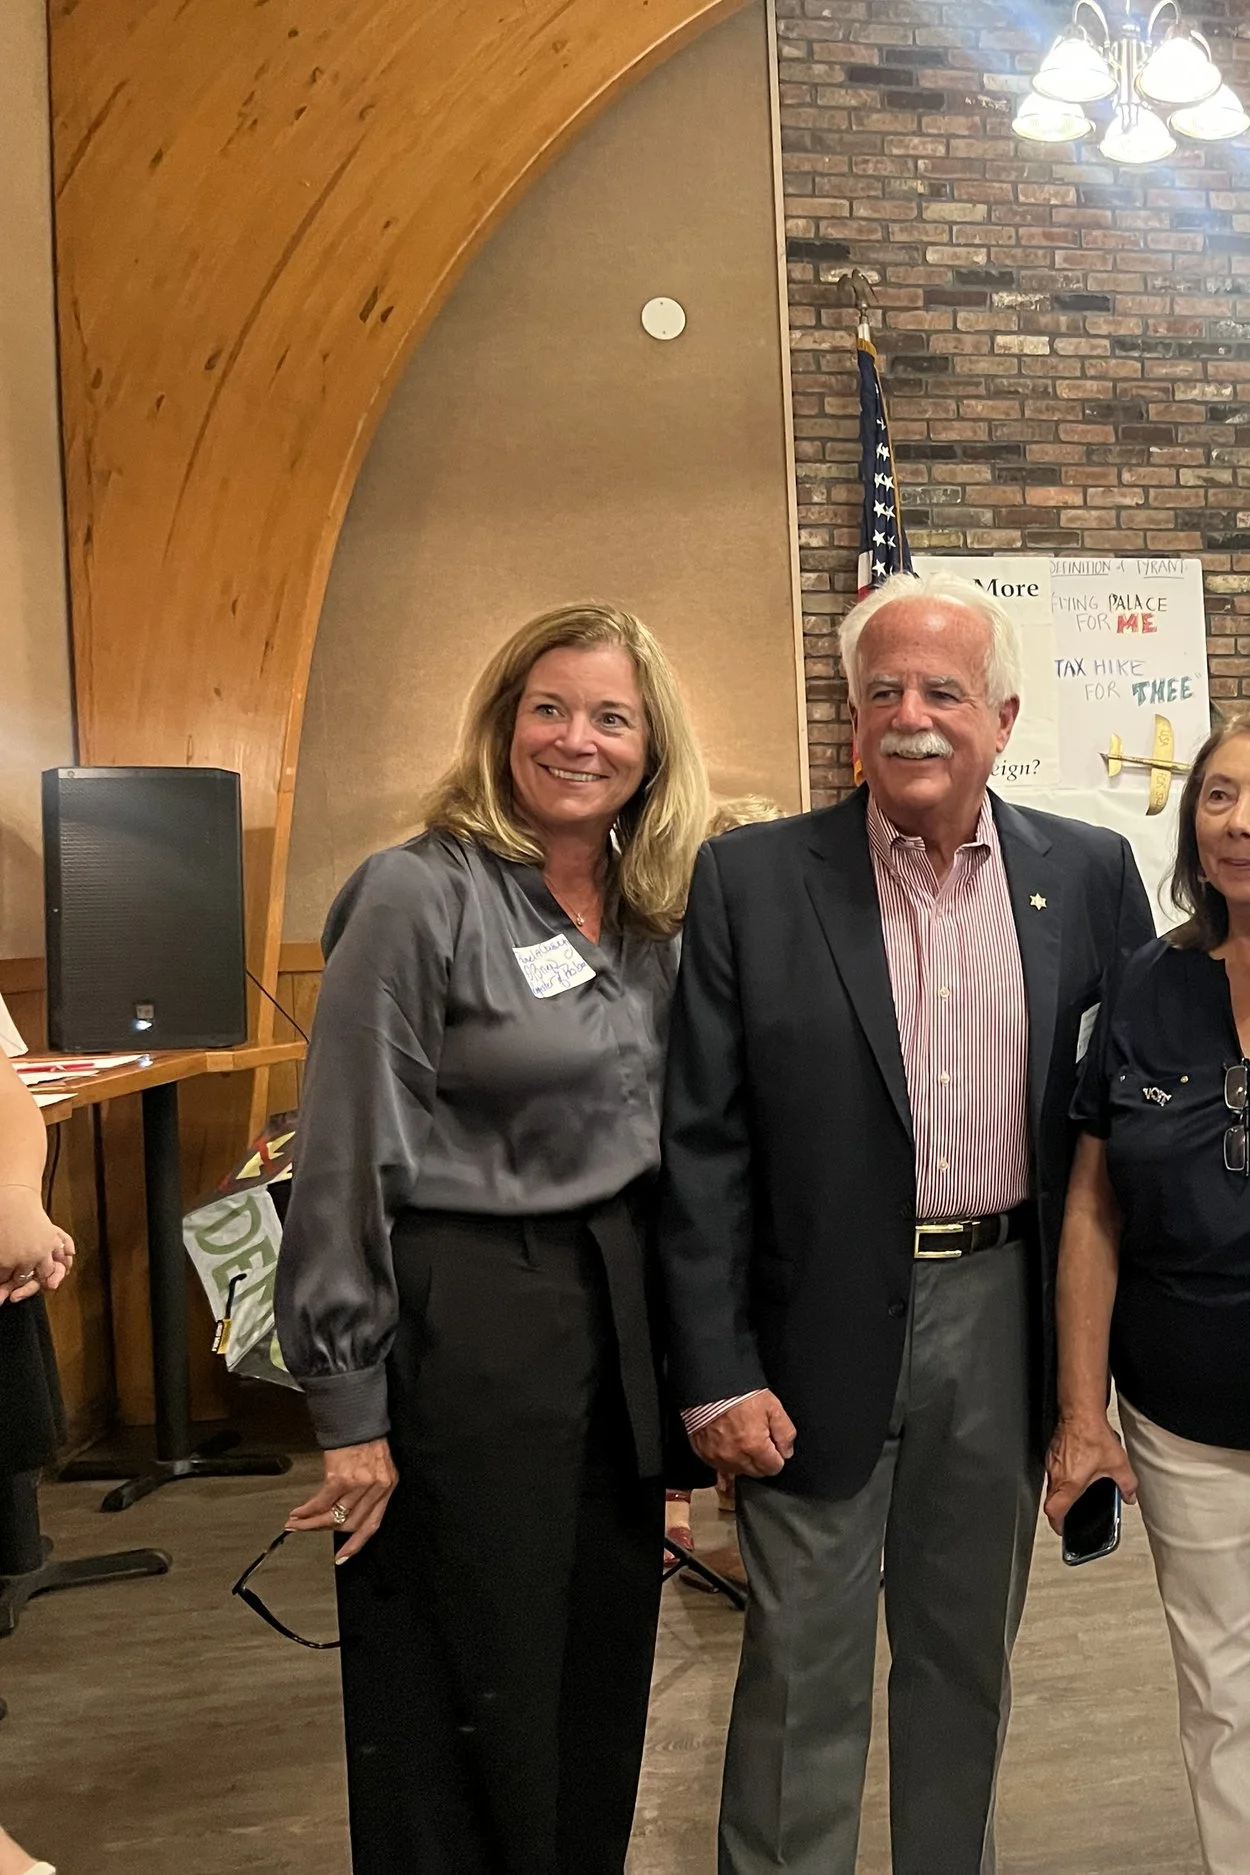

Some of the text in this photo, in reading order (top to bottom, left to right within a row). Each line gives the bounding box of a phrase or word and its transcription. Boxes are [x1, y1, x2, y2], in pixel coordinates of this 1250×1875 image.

[1050, 560, 1111, 575] DEFINITION
[973, 579, 1040, 597] More
[1109, 593, 1167, 612] PALACE
[1076, 612, 1157, 634] FOR ME
[1055, 658, 1145, 677] TAX HIKE
[1085, 681, 1121, 701] FOR
[1158, 730, 1170, 747] USA
[991, 759, 1041, 781] eign?
